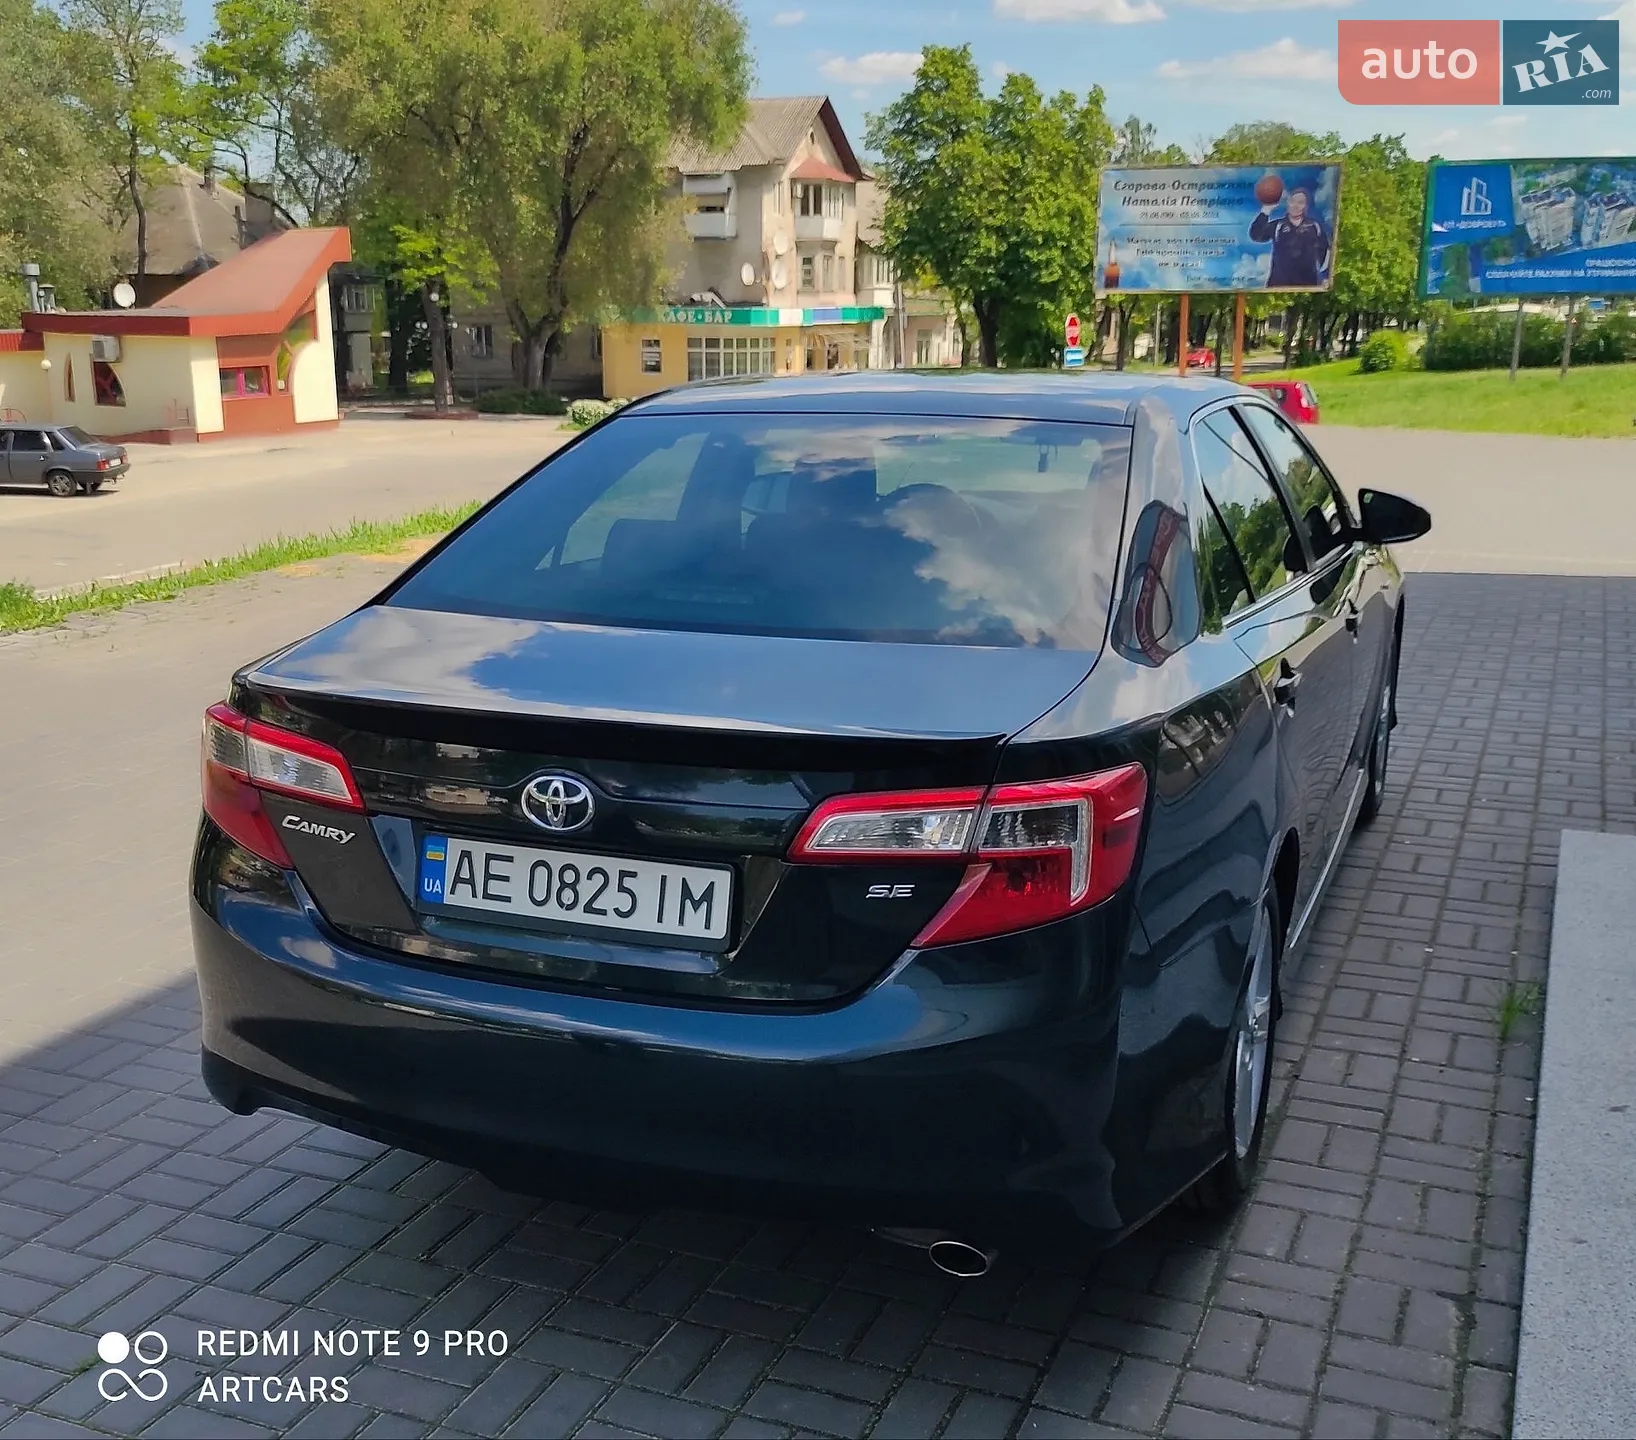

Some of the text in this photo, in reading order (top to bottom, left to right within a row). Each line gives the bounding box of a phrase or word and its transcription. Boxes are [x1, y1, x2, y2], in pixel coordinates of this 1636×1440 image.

[282, 814, 356, 845] CAMRY
[424, 848, 718, 931] UA AE 0825 IM
[865, 884, 916, 899] SE
